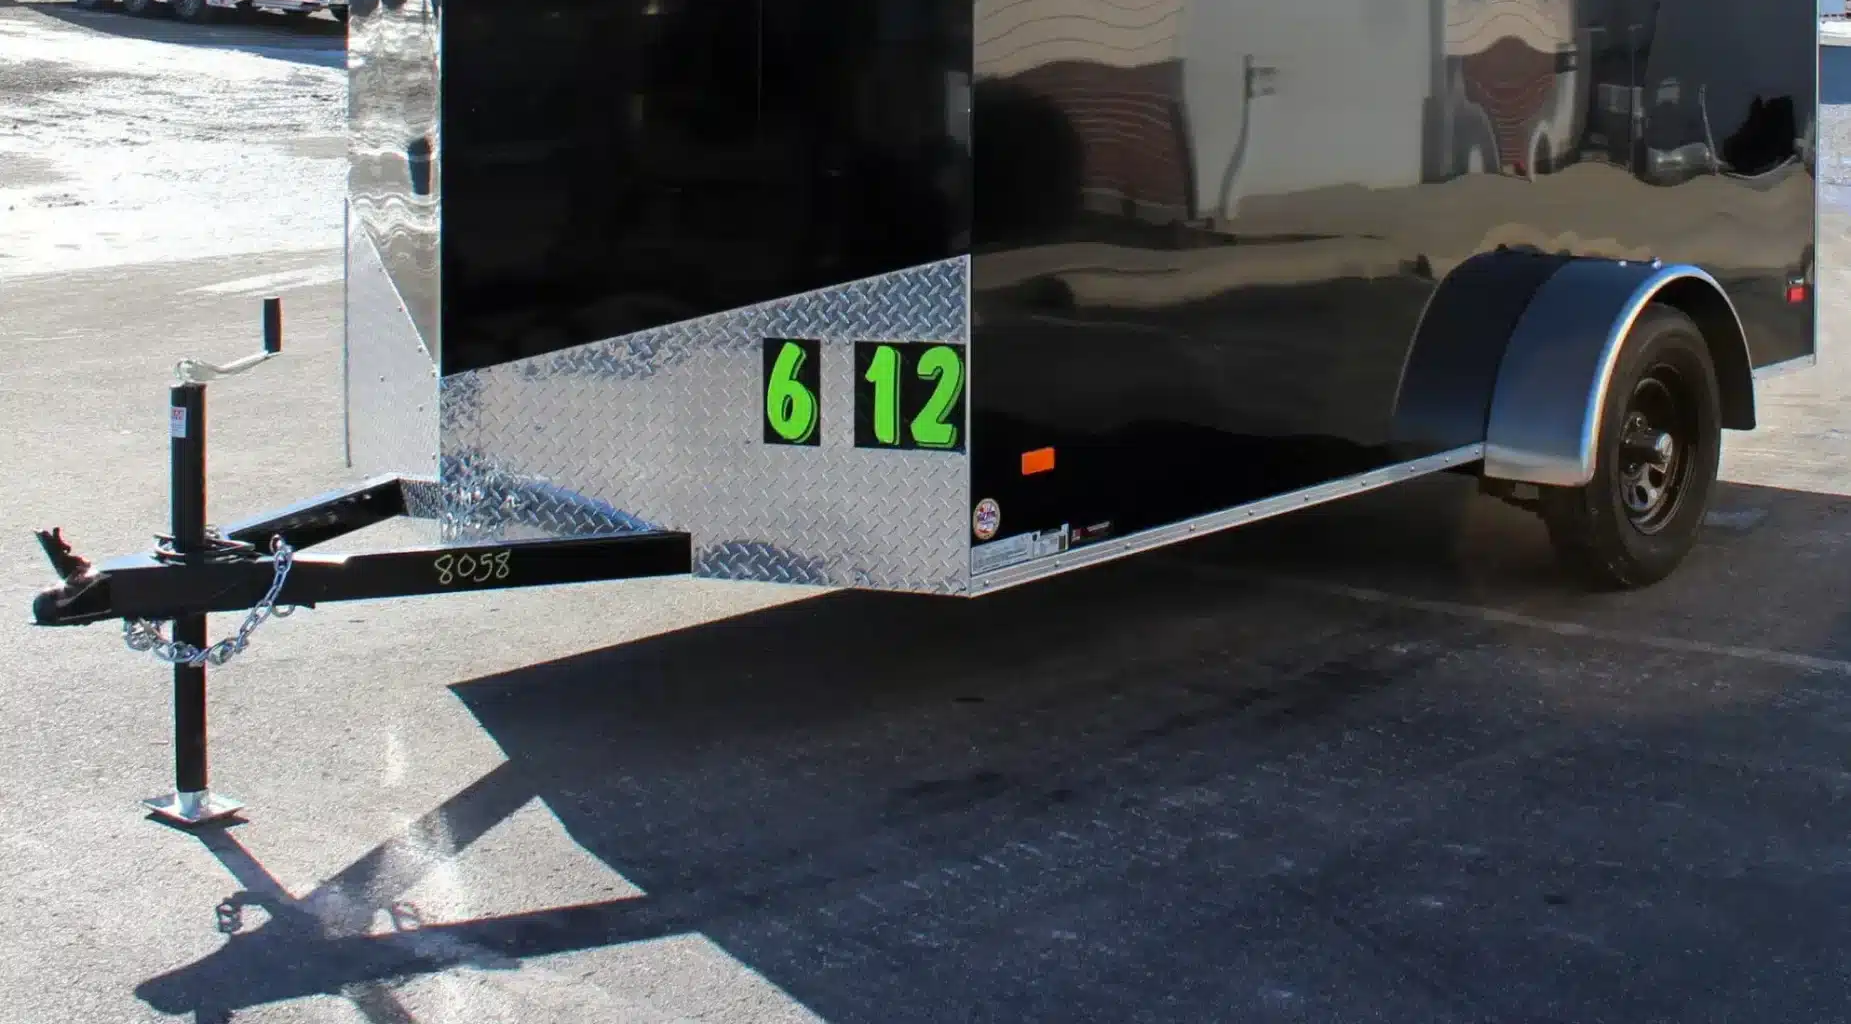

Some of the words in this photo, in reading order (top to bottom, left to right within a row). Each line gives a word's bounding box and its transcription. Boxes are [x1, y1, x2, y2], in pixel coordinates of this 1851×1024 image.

[767, 342, 818, 443] 6
[865, 345, 964, 448] 12
[434, 548, 512, 585] 8058
